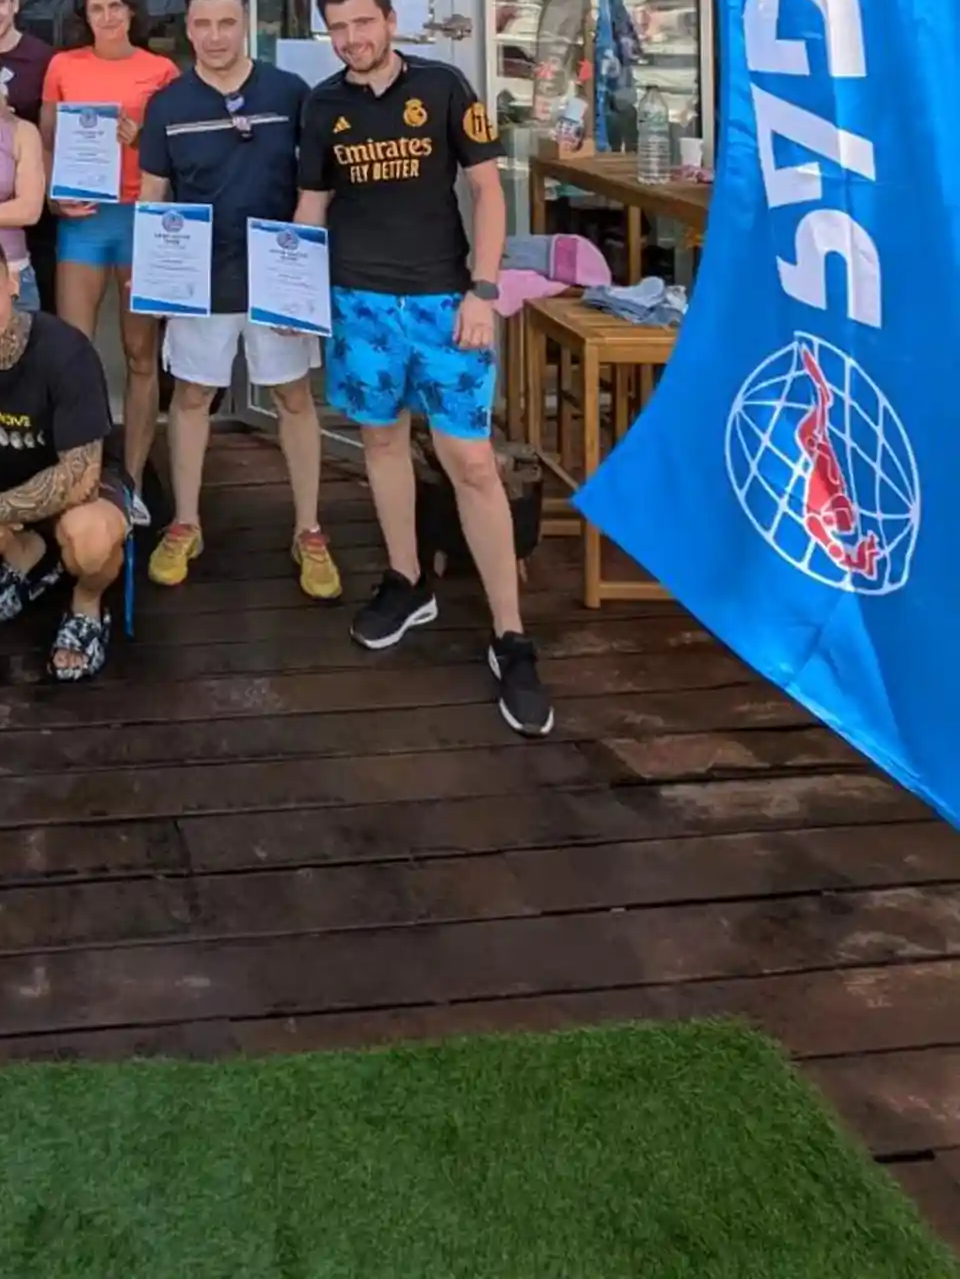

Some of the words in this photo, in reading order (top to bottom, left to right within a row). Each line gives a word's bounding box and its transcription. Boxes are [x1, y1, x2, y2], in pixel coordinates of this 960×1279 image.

[333, 136, 433, 166] Emirates
[350, 164, 369, 183] FLY
[373, 158, 420, 181] BETTER
